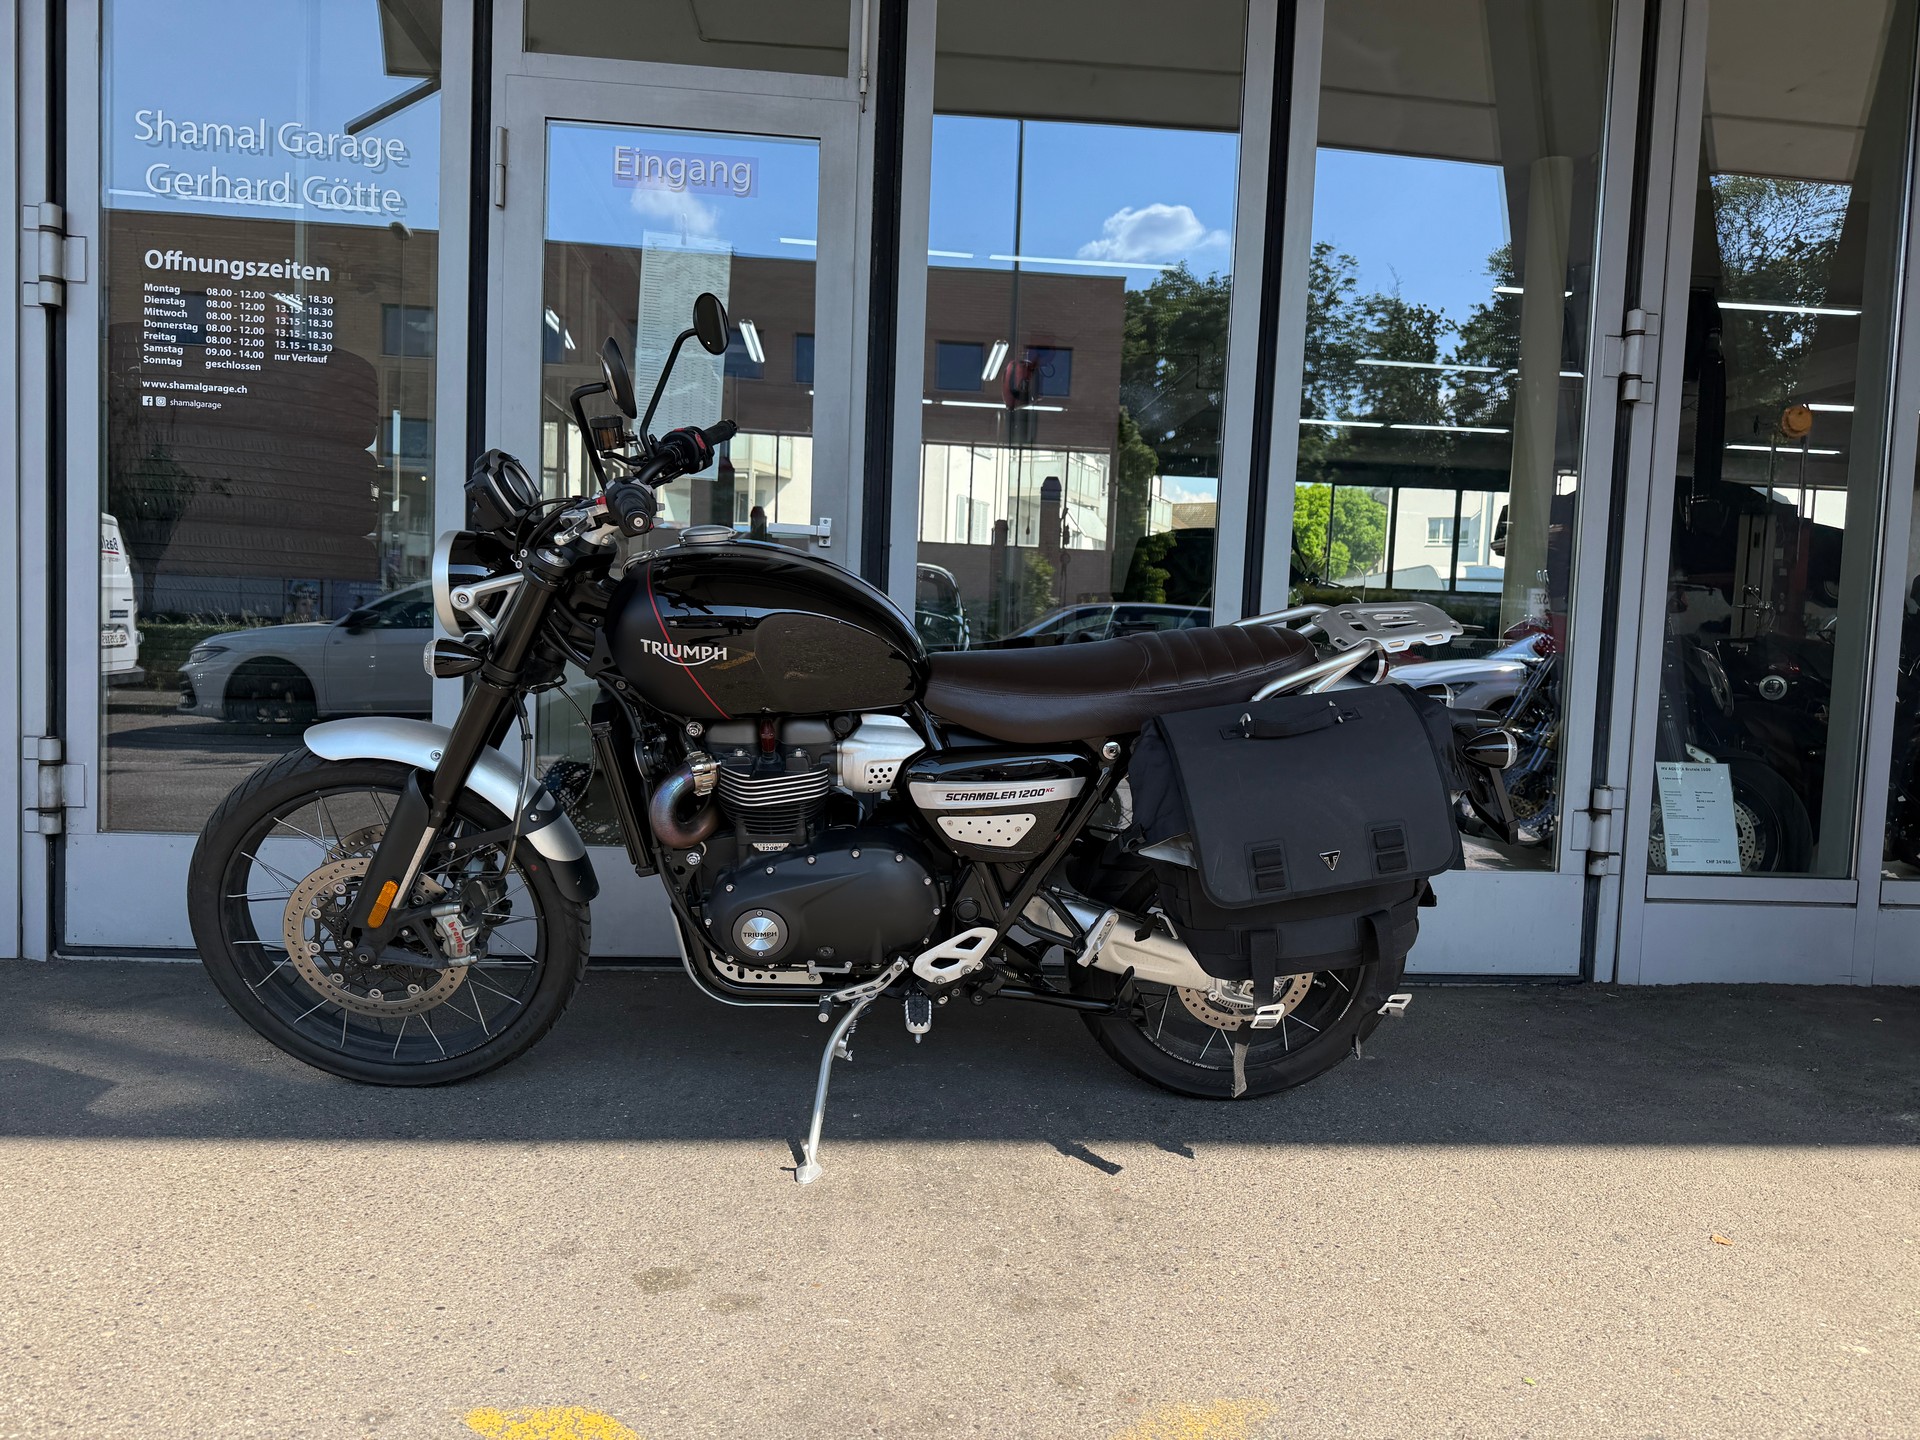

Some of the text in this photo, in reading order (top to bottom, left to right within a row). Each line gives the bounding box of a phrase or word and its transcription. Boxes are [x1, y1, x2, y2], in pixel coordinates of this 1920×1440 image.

[134, 109, 405, 167] Shamal Garage
[614, 145, 751, 193] Eingang
[145, 163, 401, 212] Gerhard Götte
[144, 283, 180, 295] Montag
[206, 288, 232, 297] 08.00
[240, 290, 265, 299] 12.00
[308, 295, 333, 304] 18.30
[144, 295, 185, 307] Dienstag
[206, 300, 232, 309] 08.00
[240, 302, 265, 311] 12.00
[276, 304, 300, 313] 13.15
[308, 307, 333, 316] 18.30
[143, 307, 188, 318] Mittwoch
[206, 312, 232, 321] 08.00
[240, 314, 265, 323] 12.00
[275, 316, 300, 325] 13.15
[308, 319, 333, 328] 18.30
[143, 319, 198, 333] Donnerstag
[205, 324, 231, 333] 08.00
[239, 326, 264, 335] 12.00
[275, 328, 300, 337] 13.15
[308, 331, 333, 340] 18.30
[143, 331, 176, 343] Freitag
[205, 336, 231, 345] 08.00
[239, 338, 264, 347] 12.00
[275, 340, 299, 349] 13.15
[308, 343, 333, 352] 18.30
[143, 343, 183, 355] Samstag
[205, 348, 231, 357] 09.00
[239, 350, 264, 359] 14.00
[291, 353, 328, 363] Verkauf
[143, 355, 261, 370] Sonntag geschlossen
[142, 381, 248, 394] www.shamalgarage.ch
[169, 399, 222, 410] shamalgarage
[640, 639, 727, 664] TRIUMPH
[945, 791, 1017, 801] SCRAMBLER
[1018, 788, 1045, 798] 1200
[448, 921, 465, 954] brembo
[743, 931, 777, 939] TRIUMPH
